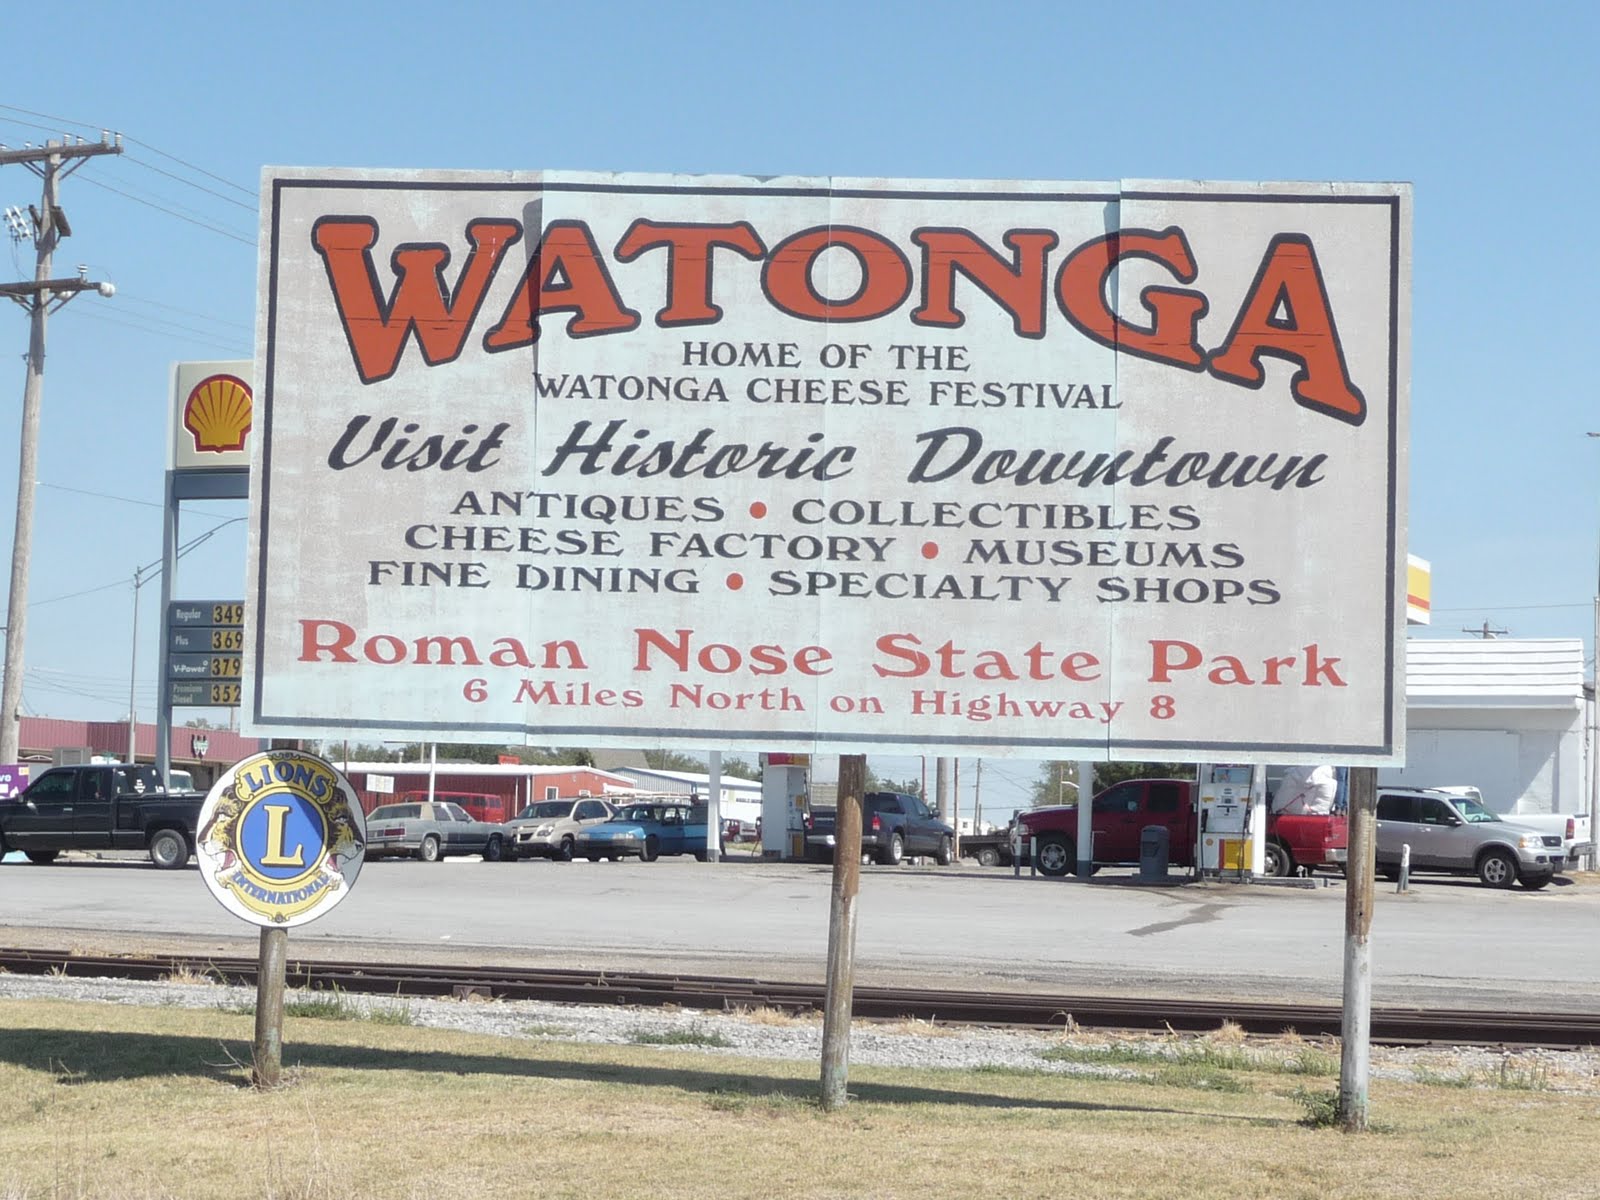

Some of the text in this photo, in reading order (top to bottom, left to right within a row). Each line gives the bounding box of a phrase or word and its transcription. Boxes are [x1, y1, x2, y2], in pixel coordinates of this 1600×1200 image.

[311, 215, 1367, 426] WATONGA
[682, 341, 971, 373] HOME OF THE
[533, 372, 1124, 410] WATONGA CHEESE FESTIVAL
[327, 414, 1329, 490] Visit Historic Downtown
[450, 490, 1201, 531] ANTIQUES COLLECTIBLES
[404, 525, 1245, 569] CHEESE FACTORY MUSEUMS
[367, 560, 1282, 606] FINE DINING SPECIALTY SHOPS
[176, 606, 244, 624] Regular 349
[175, 631, 243, 650] Plus 369
[298, 619, 1348, 687] Roman Nose State Park
[211, 658, 242, 676] 379
[211, 684, 241, 703] 352
[463, 678, 1176, 723] 6 Miles North on Highway 8
[244, 760, 330, 797] LIONS
[259, 804, 305, 867] L
[231, 870, 331, 905] INTERNATIONAL
